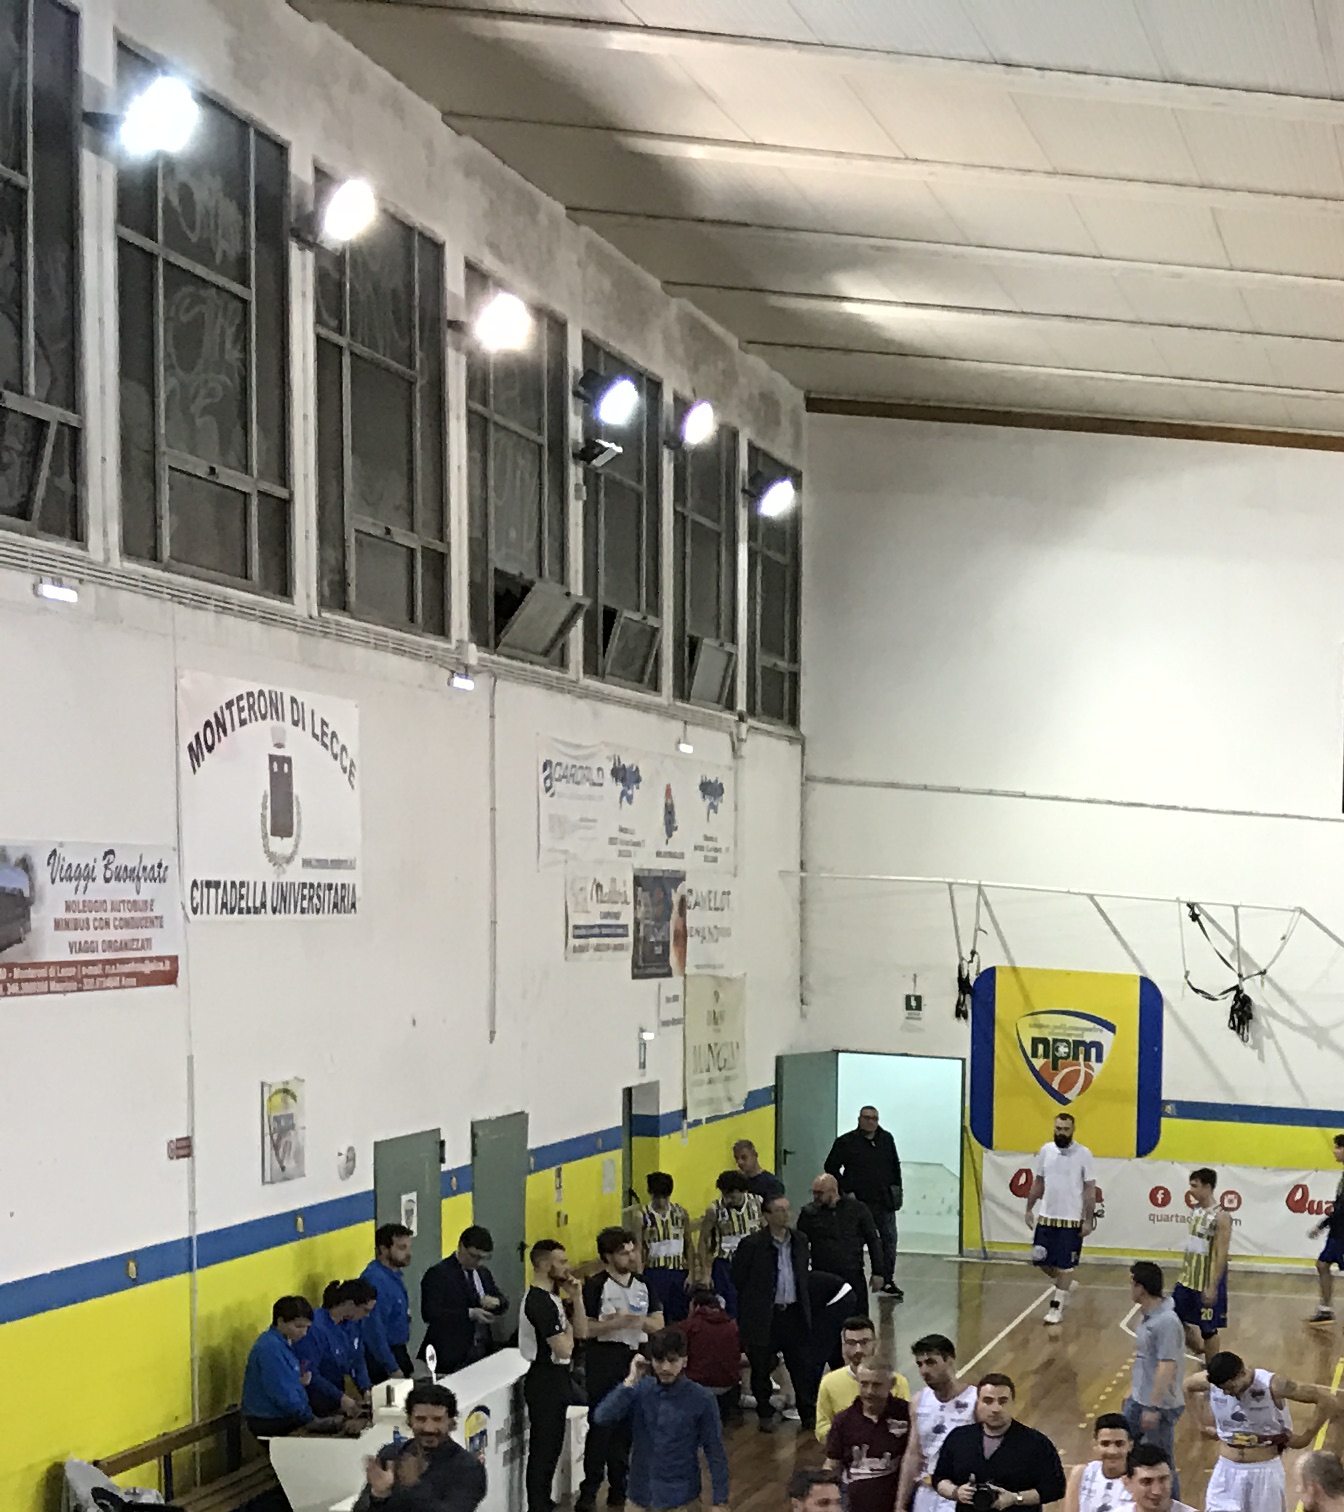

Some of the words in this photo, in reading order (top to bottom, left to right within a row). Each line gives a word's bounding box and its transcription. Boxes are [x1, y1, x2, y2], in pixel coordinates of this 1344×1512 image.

[187, 689, 286, 775] MONTERONI
[290, 696, 306, 732] DI
[311, 709, 357, 790] LECCE
[47, 848, 97, 894] Viaggi
[191, 879, 267, 915] CITTADELLA
[271, 881, 357, 915] UNIVERSITARIA
[1031, 1036, 1104, 1072] npm
